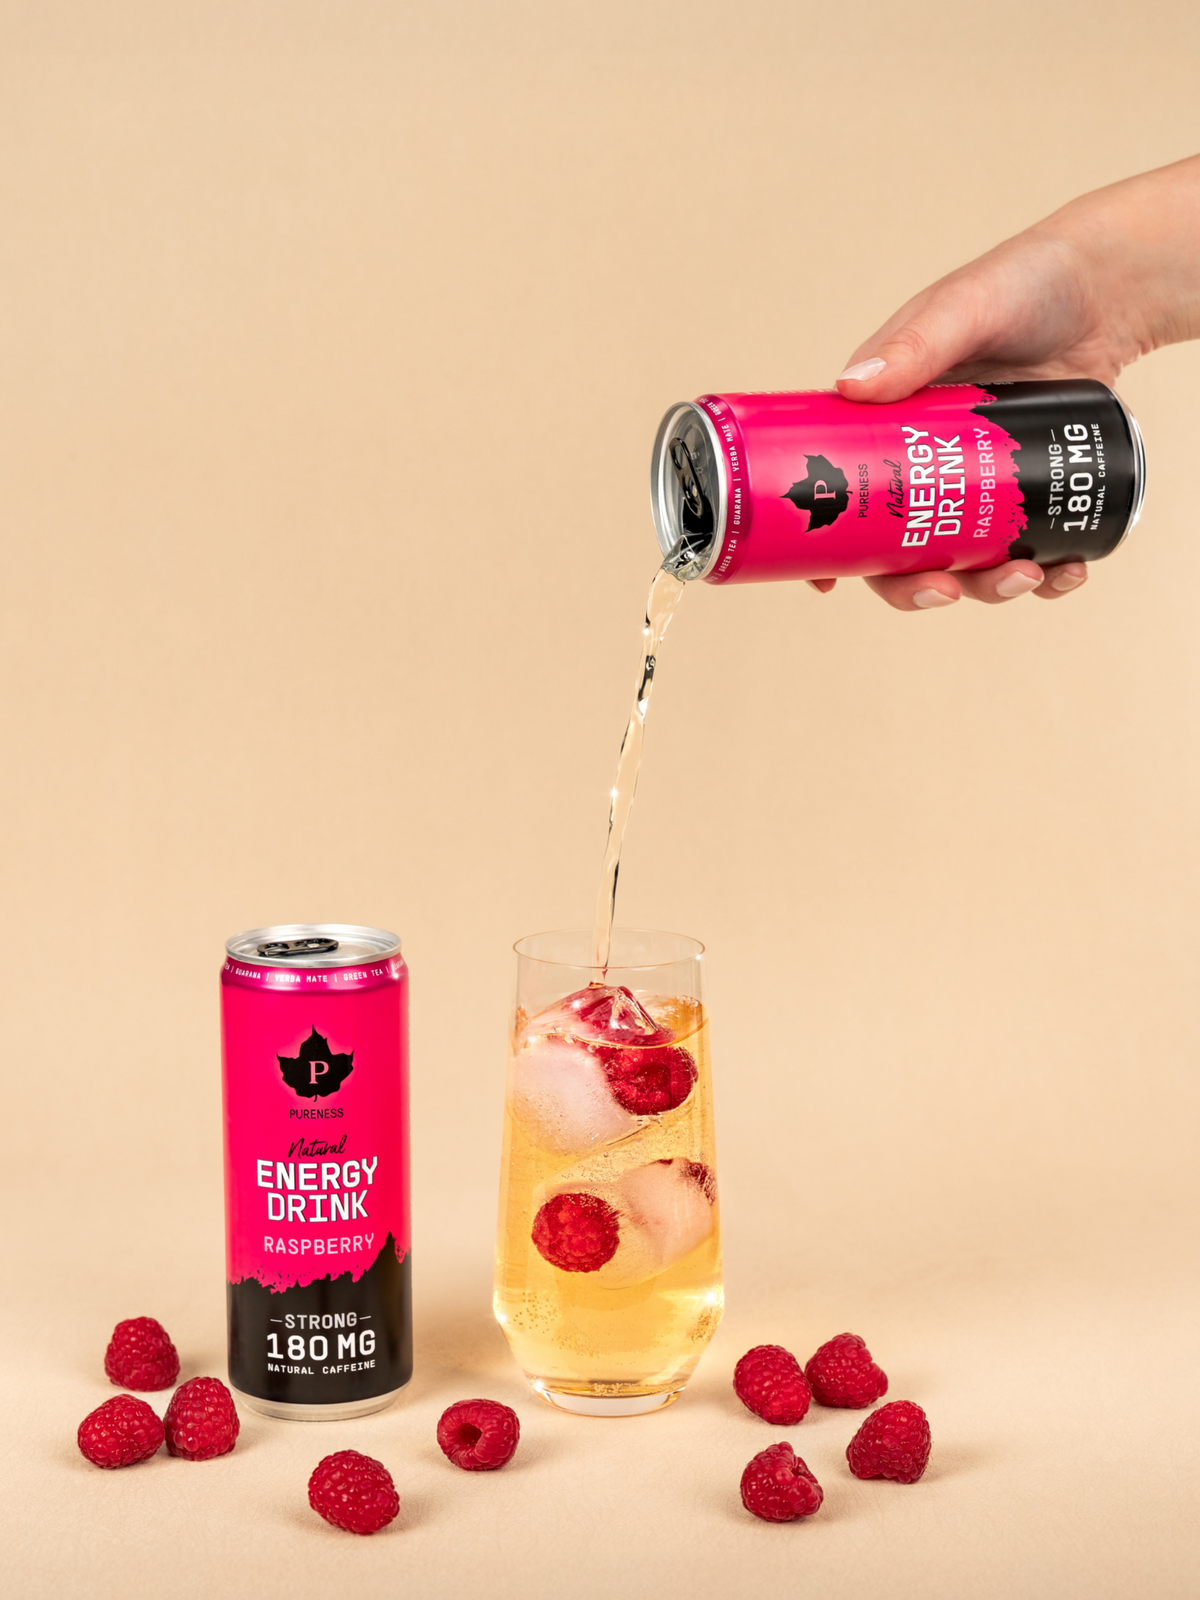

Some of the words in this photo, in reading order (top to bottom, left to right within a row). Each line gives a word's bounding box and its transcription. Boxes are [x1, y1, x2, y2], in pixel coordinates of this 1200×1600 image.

[721, 424, 734, 442] MATE
[1064, 423, 1093, 463] MG
[729, 446, 740, 472] YERBA
[1090, 423, 1106, 478] CAFFEINE
[814, 480, 836, 500] P
[858, 463, 869, 518] PURENESS
[883, 459, 904, 518] Natural
[901, 425, 936, 547] ENERGY
[933, 434, 966, 536] DRINK
[973, 428, 996, 538] RASPBERRY
[1048, 443, 1064, 516] STRONG
[733, 488, 742, 525] GUARANA
[1063, 472, 1094, 531] 180
[1090, 485, 1106, 530] NATURAL
[728, 540, 737, 552] TEA
[235, 967, 261, 980] GUARANA
[275, 973, 301, 983] YERBA
[306, 974, 328, 983] MATE
[343, 971, 368, 981] GREEN
[371, 968, 384, 977] TEA
[309, 1061, 329, 1084] P
[289, 1108, 344, 1119] PURENESS
[288, 1134, 347, 1159] Natural
[256, 1156, 378, 1191] ENERGY
[267, 1189, 369, 1223] DRINK
[264, 1233, 374, 1255] RASPBERRY
[284, 1312, 358, 1330] STRONG
[267, 1332, 328, 1361] 180
[337, 1329, 376, 1359] MG
[267, 1363, 314, 1375] NATURAL
[322, 1359, 376, 1375] CAFFEINE
